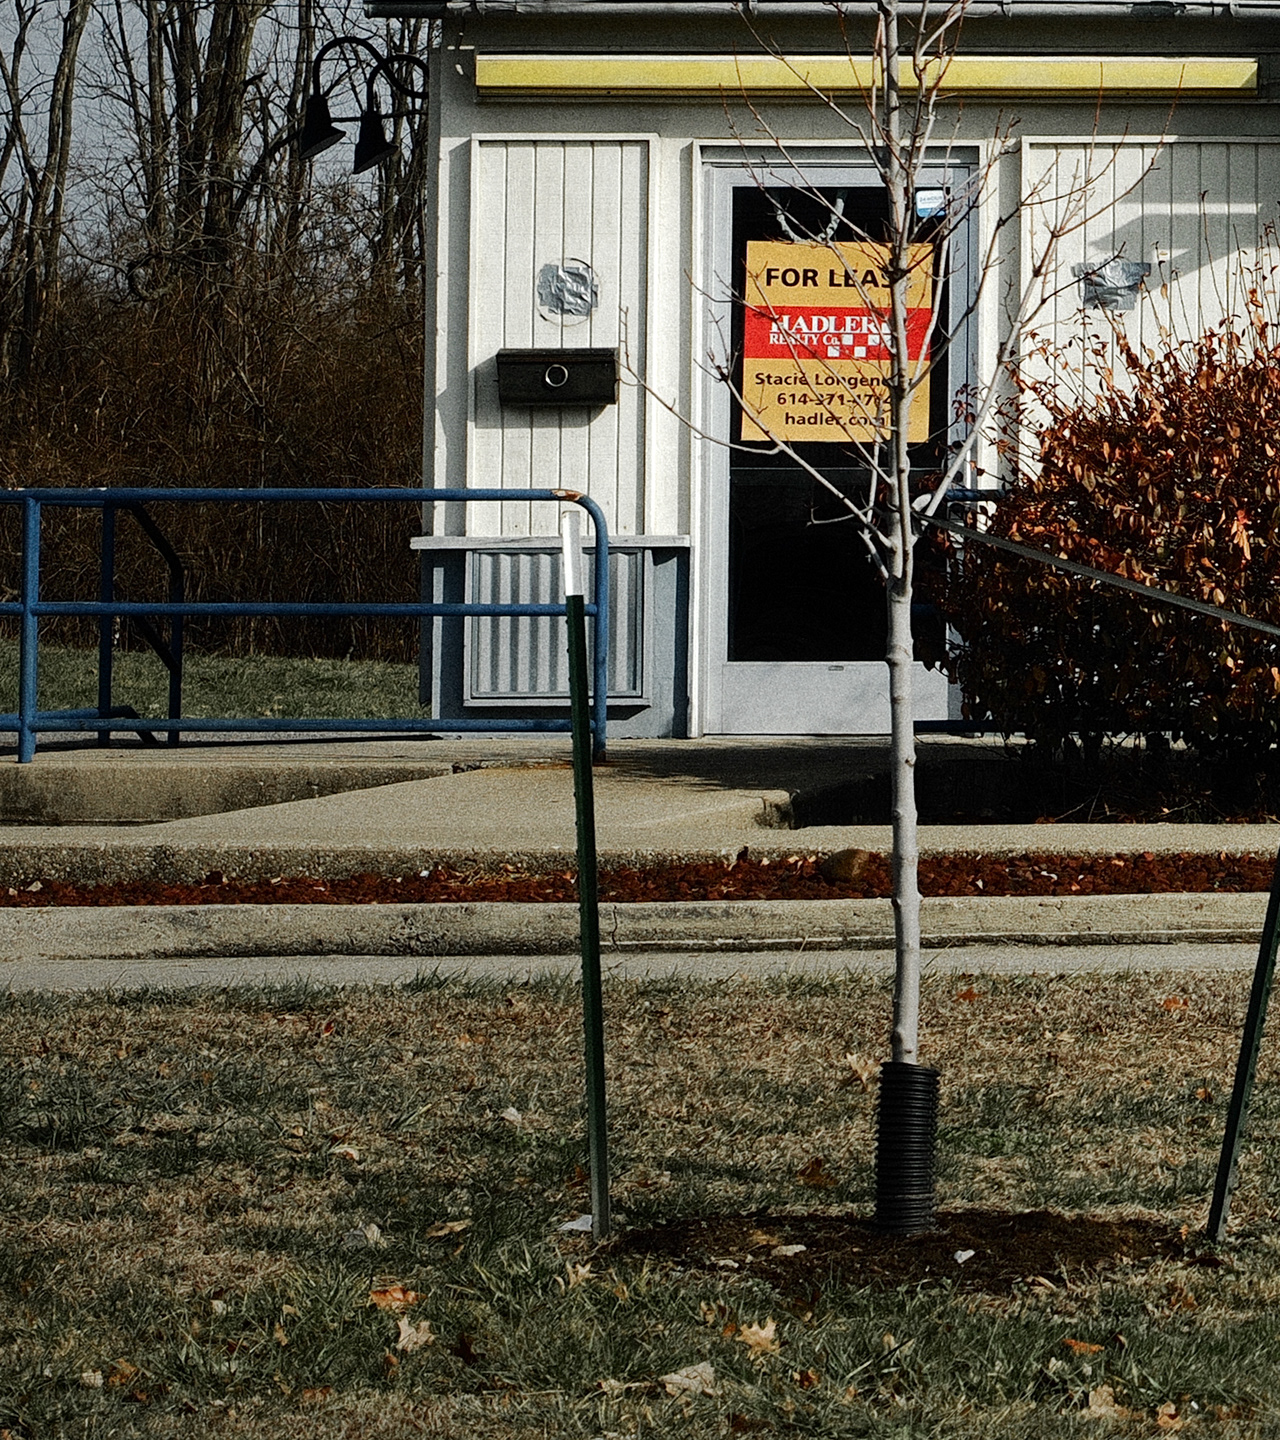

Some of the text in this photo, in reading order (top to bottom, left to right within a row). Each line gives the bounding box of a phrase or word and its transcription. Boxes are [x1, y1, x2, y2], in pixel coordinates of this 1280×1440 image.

[765, 268, 911, 288] FOR LEAS
[769, 334, 820, 345] REALTY
[755, 372, 808, 386] Stacie
